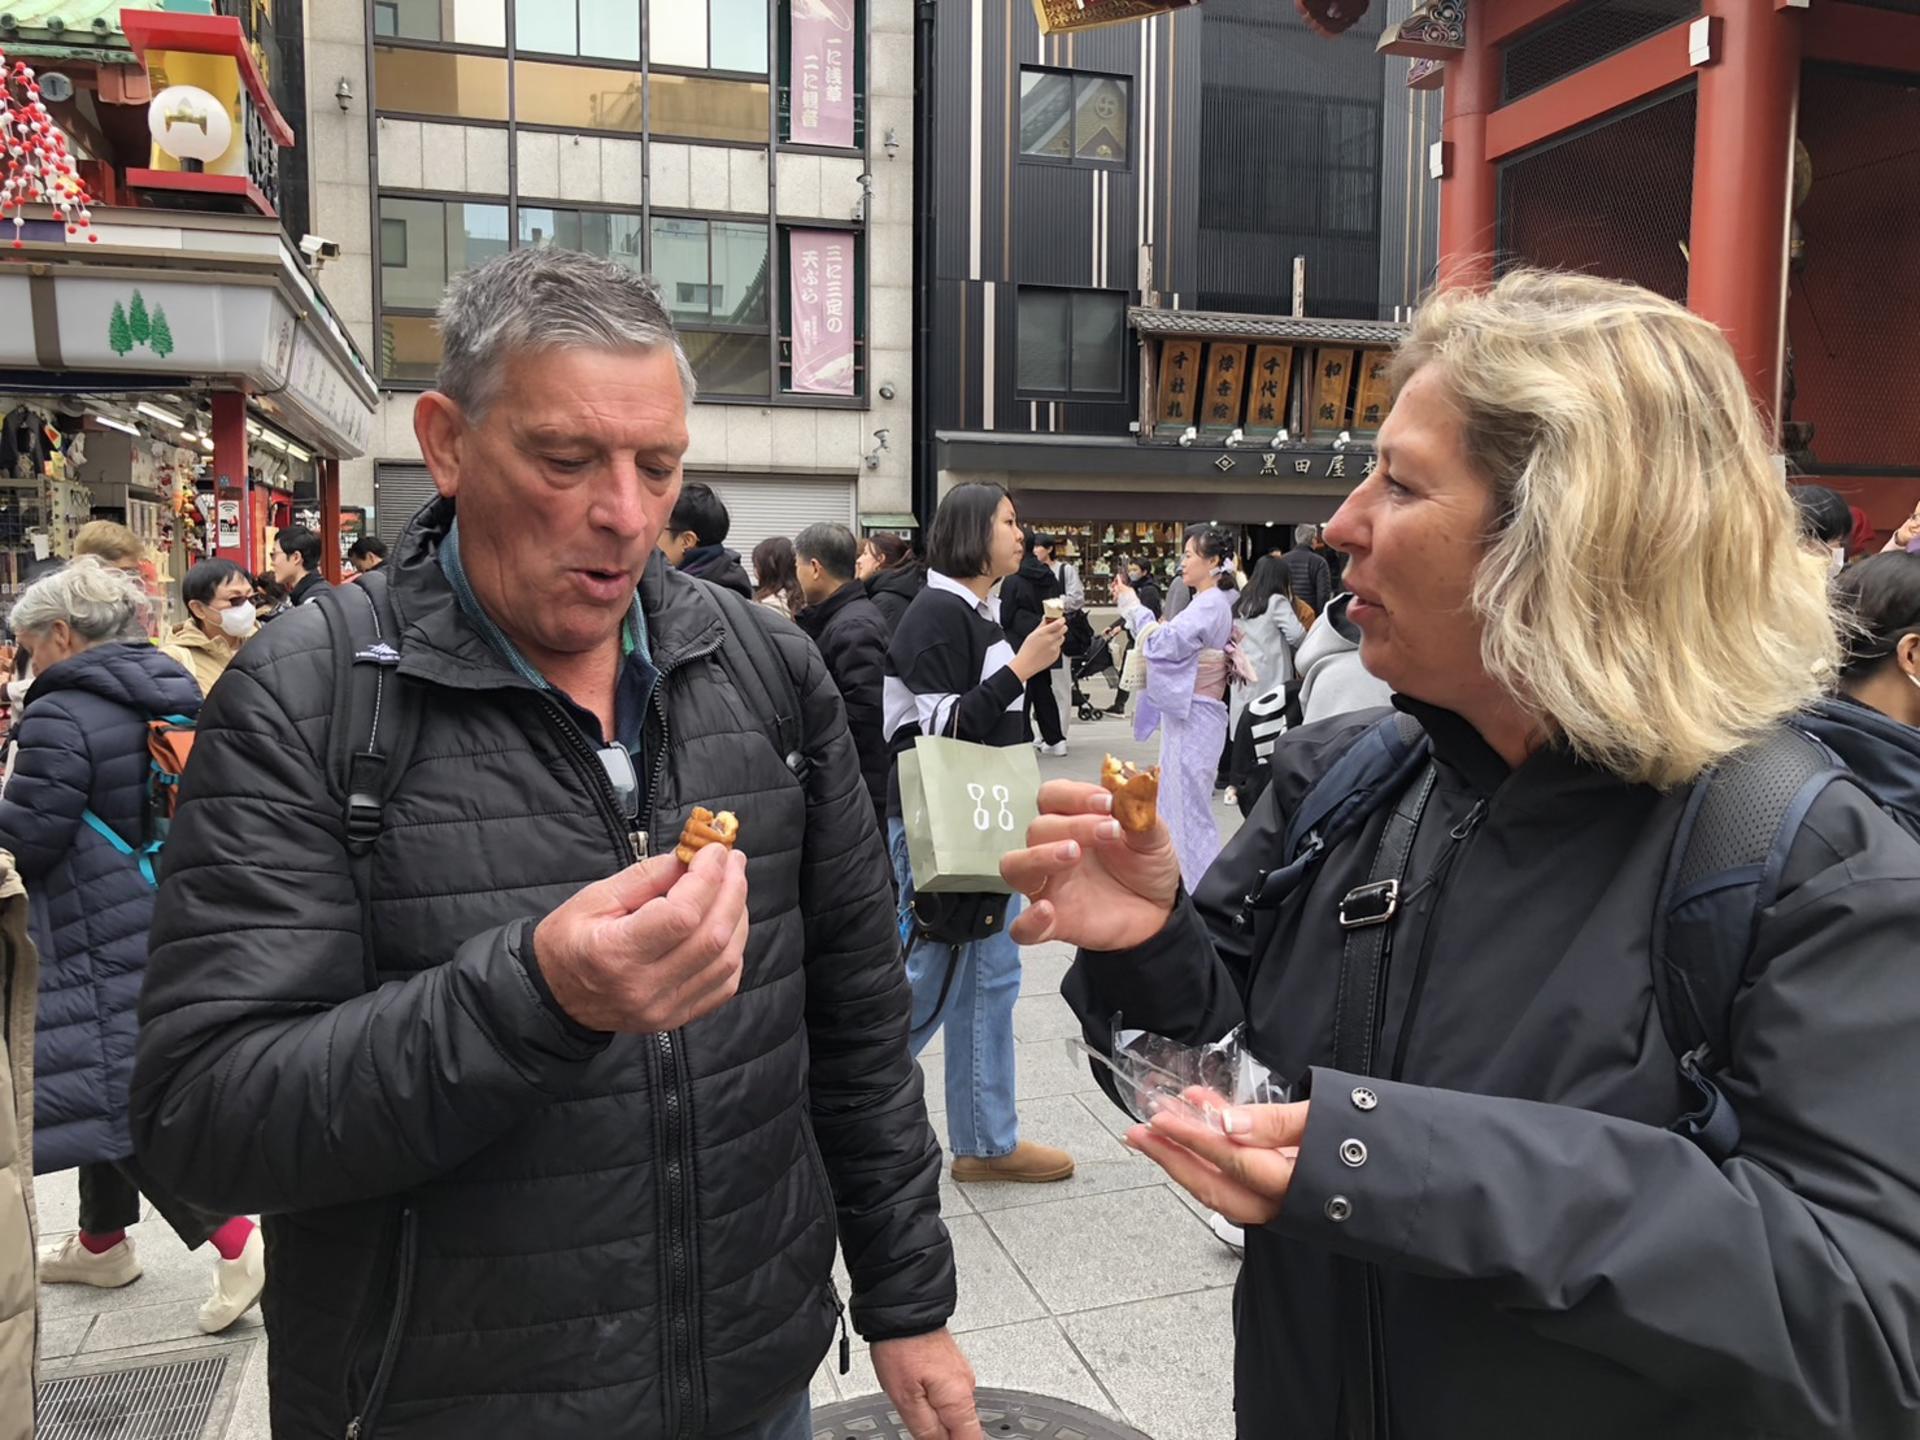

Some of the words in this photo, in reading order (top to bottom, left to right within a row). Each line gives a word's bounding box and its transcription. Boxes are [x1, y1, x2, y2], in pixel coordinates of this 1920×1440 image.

[801, 250, 819, 304] 天ぷら
[1258, 356, 1281, 421] 千代紙
